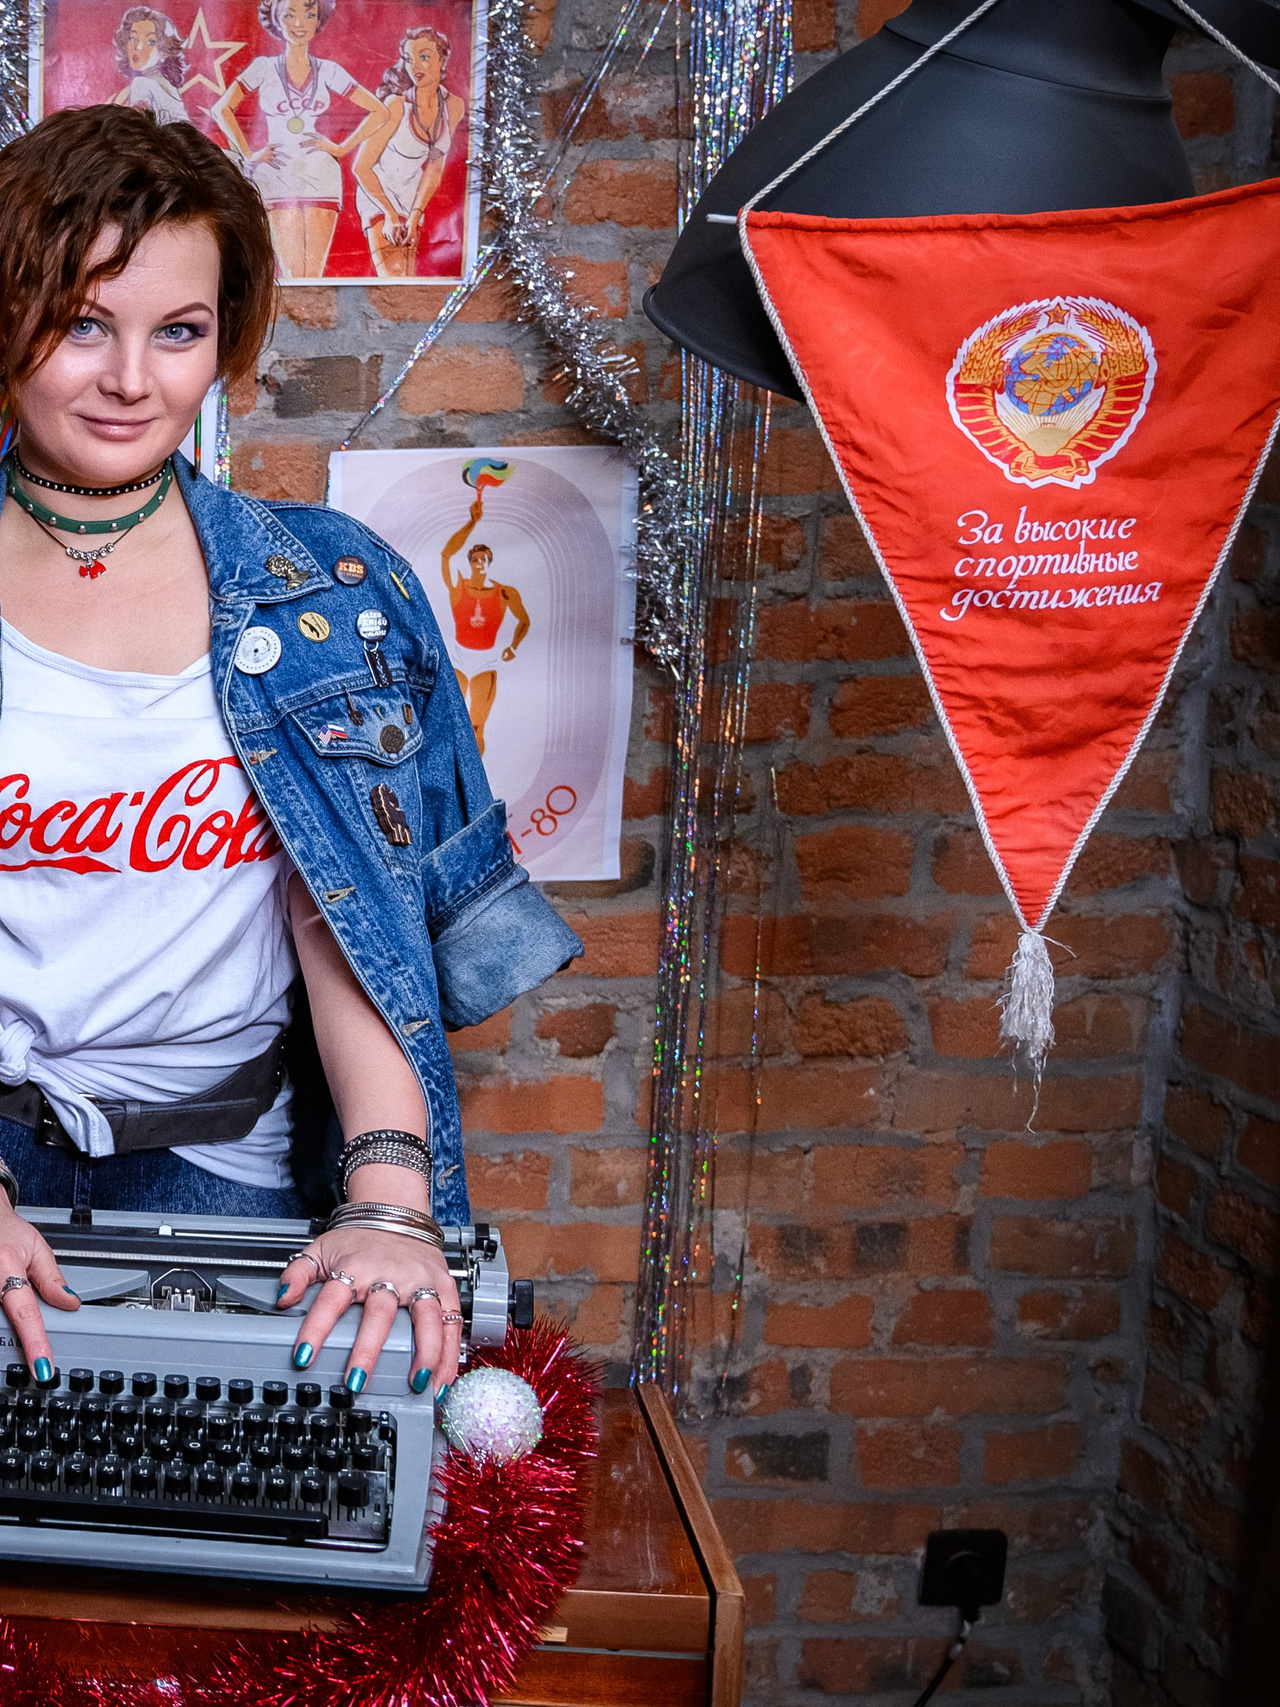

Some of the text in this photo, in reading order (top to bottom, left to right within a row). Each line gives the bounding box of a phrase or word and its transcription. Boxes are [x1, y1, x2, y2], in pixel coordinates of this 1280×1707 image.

[276, 97, 325, 113] СССР
[956, 505, 1137, 545] За высокие
[953, 539, 1140, 590] спортивные
[939, 580, 1163, 622] достижения
